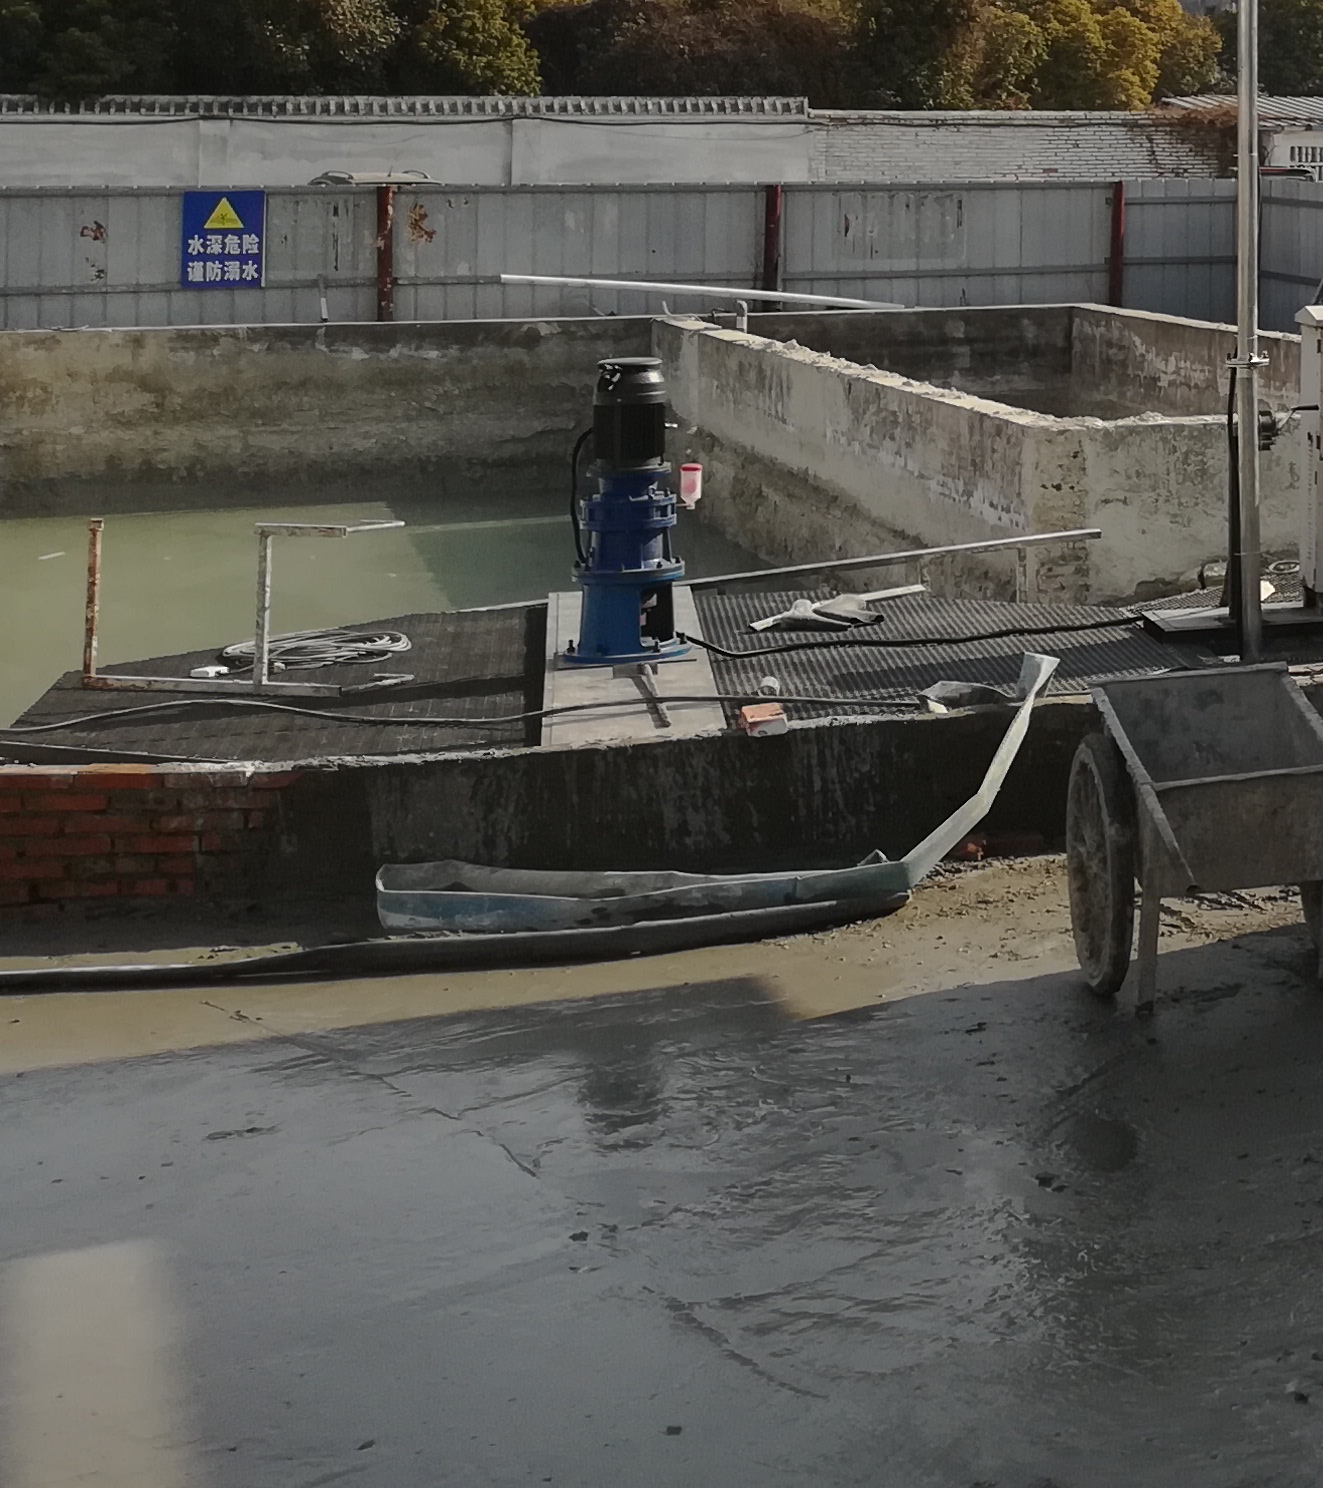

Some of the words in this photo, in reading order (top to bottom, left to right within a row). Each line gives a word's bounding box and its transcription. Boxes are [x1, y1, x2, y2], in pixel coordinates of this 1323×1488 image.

[187, 233, 260, 256] 水深危险
[187, 260, 259, 282] 谨防溺水
